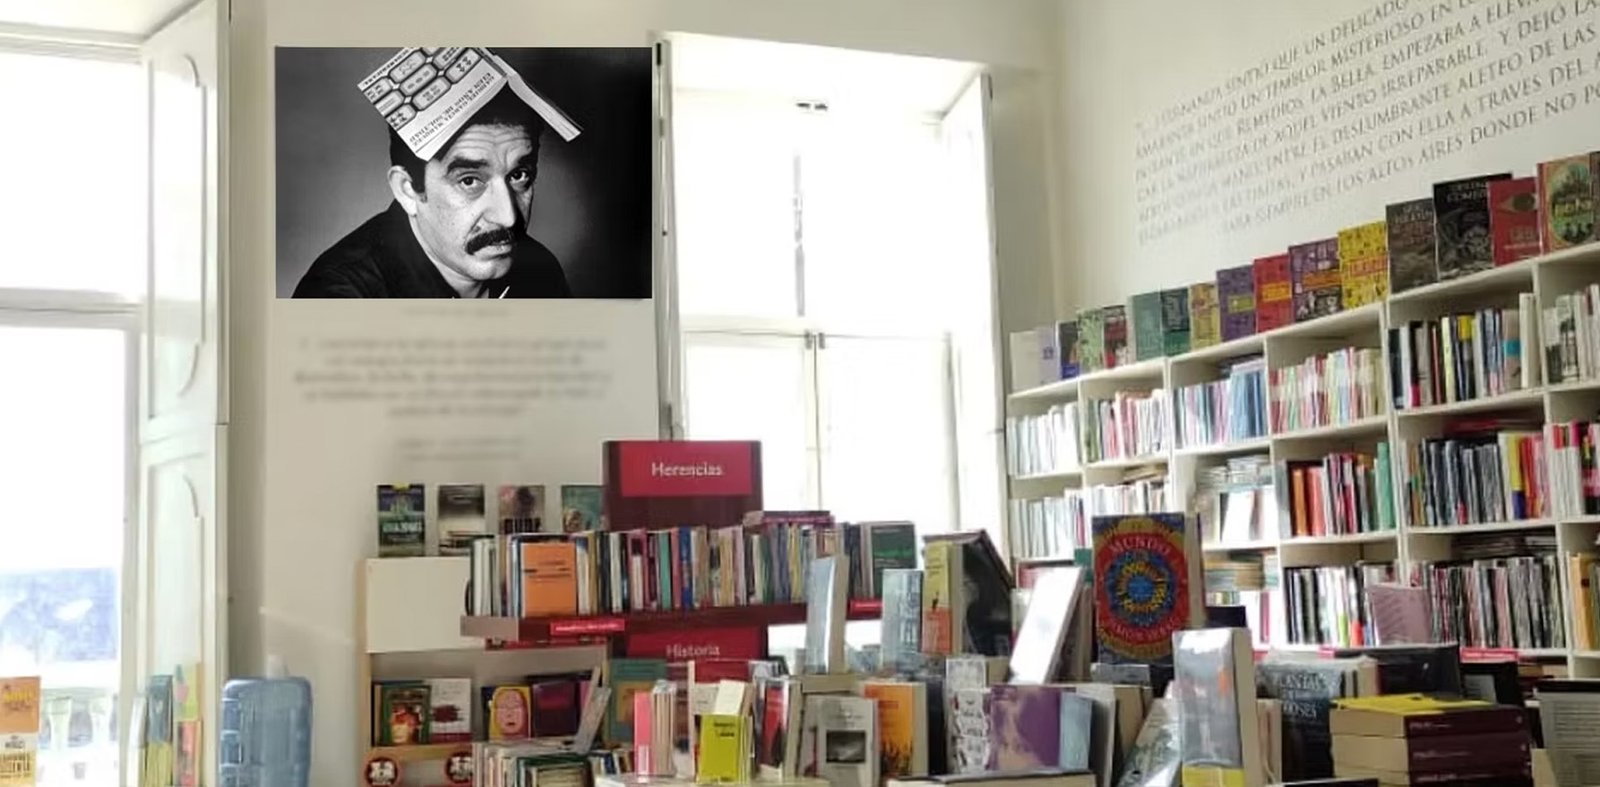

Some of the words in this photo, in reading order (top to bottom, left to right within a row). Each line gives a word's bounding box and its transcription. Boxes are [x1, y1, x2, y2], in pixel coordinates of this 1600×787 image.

[1272, 43, 1299, 73] QUE
[1303, 31, 1326, 57] UN
[1310, 79, 1327, 105] LA
[1382, 18, 1465, 72] EMPEZABA
[1470, 10, 1481, 32] A
[1320, 85, 1376, 124] VIENTO
[1496, 25, 1510, 49] Y
[1331, 9, 1424, 68] MISTERIOSO
[1430, 0, 1452, 22] EN
[1332, 79, 1452, 145] DESLUMBRANTE
[1457, 48, 1522, 94] ALETEO
[1528, 36, 1554, 65] DE
[1562, 20, 1597, 52] LAS
[1378, 123, 1412, 154] CON
[1419, 107, 1454, 137] ELLA
[1460, 100, 1471, 121] A
[1549, 55, 1584, 88] DEL
[1336, 169, 1363, 195] LOS
[1366, 151, 1414, 184] ALTOS
[1419, 131, 1462, 165] AIRES
[1470, 102, 1537, 146] DONDE
[1544, 89, 1576, 119] NO
[651, 461, 723, 477] Herencias
[665, 643, 720, 658] Historia
